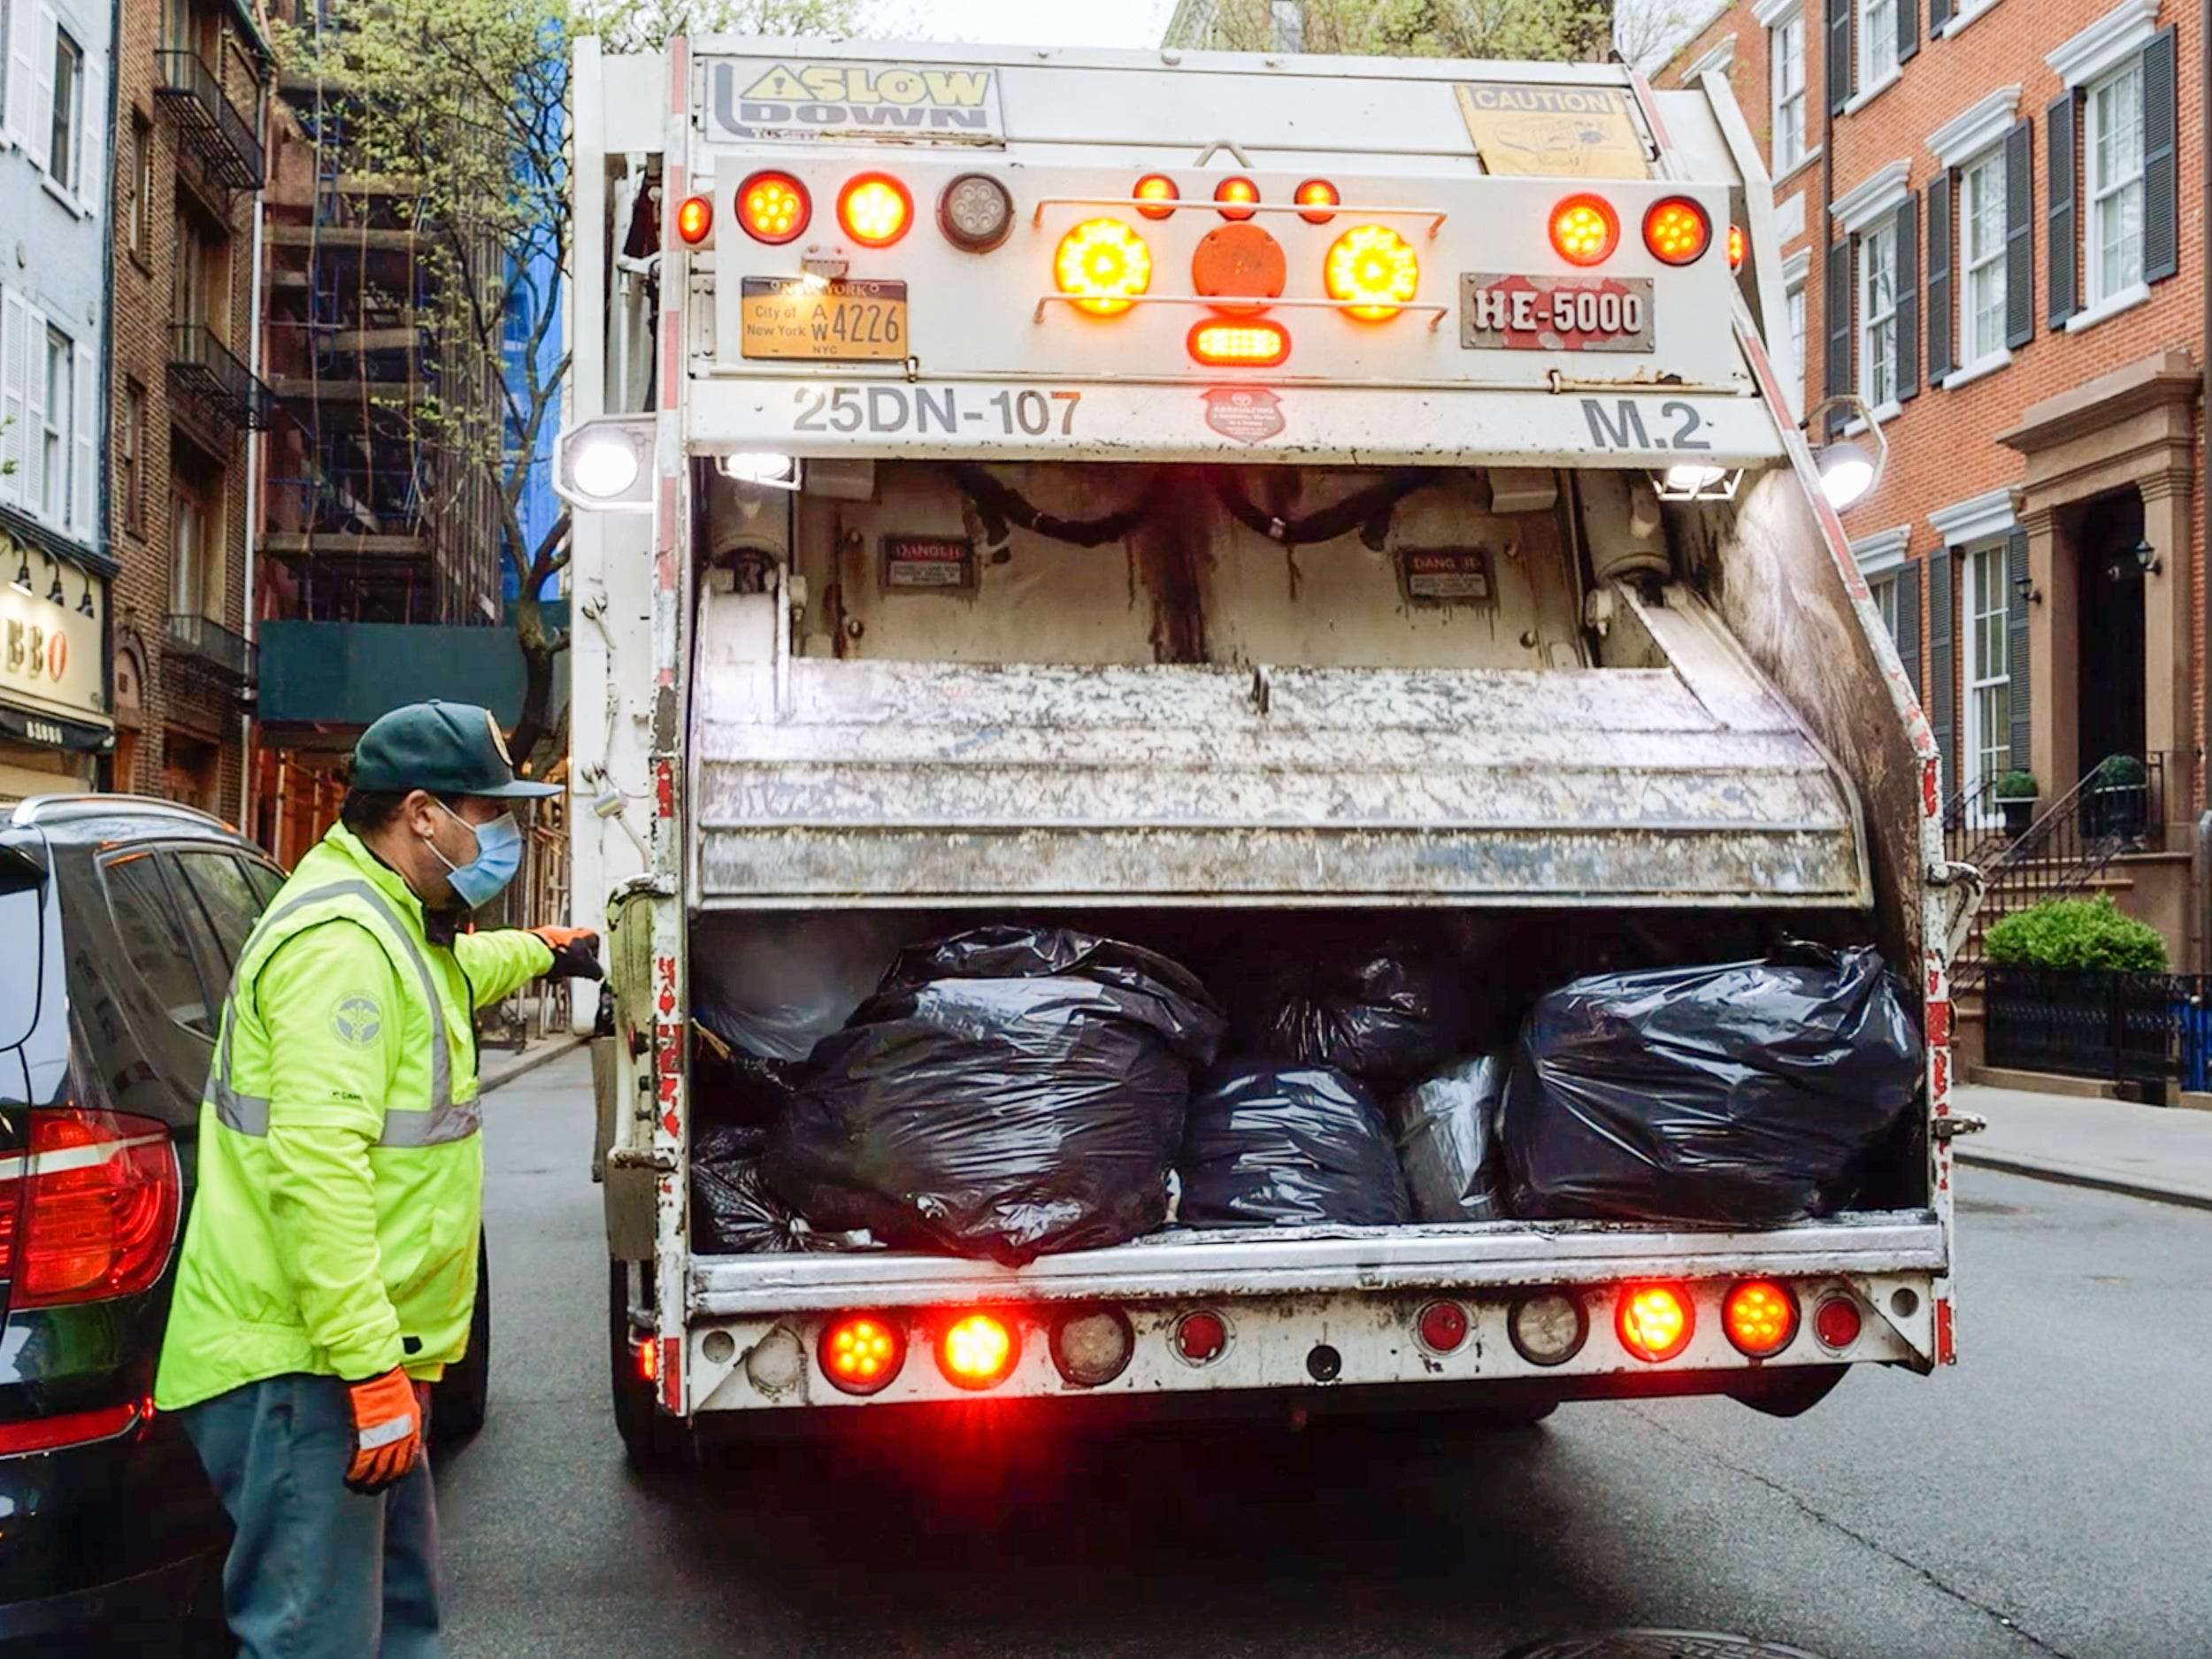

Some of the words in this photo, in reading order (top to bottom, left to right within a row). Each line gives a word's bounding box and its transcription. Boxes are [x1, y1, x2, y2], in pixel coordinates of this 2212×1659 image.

[799, 65, 991, 107] SLOW
[1474, 89, 1609, 113] CAUTION
[740, 103, 988, 128] DOWN
[826, 282, 868, 297] YORK
[755, 305, 780, 320] City
[784, 306, 796, 319] of
[811, 304, 827, 319] A
[833, 303, 900, 343] 4226
[1474, 289, 1644, 334] HE-5000
[747, 323, 776, 336] New
[779, 324, 806, 337] York
[810, 323, 828, 342] W
[812, 345, 839, 355] NYC
[793, 387, 1081, 435] 25DN-107
[1580, 399, 1711, 449] M.2
